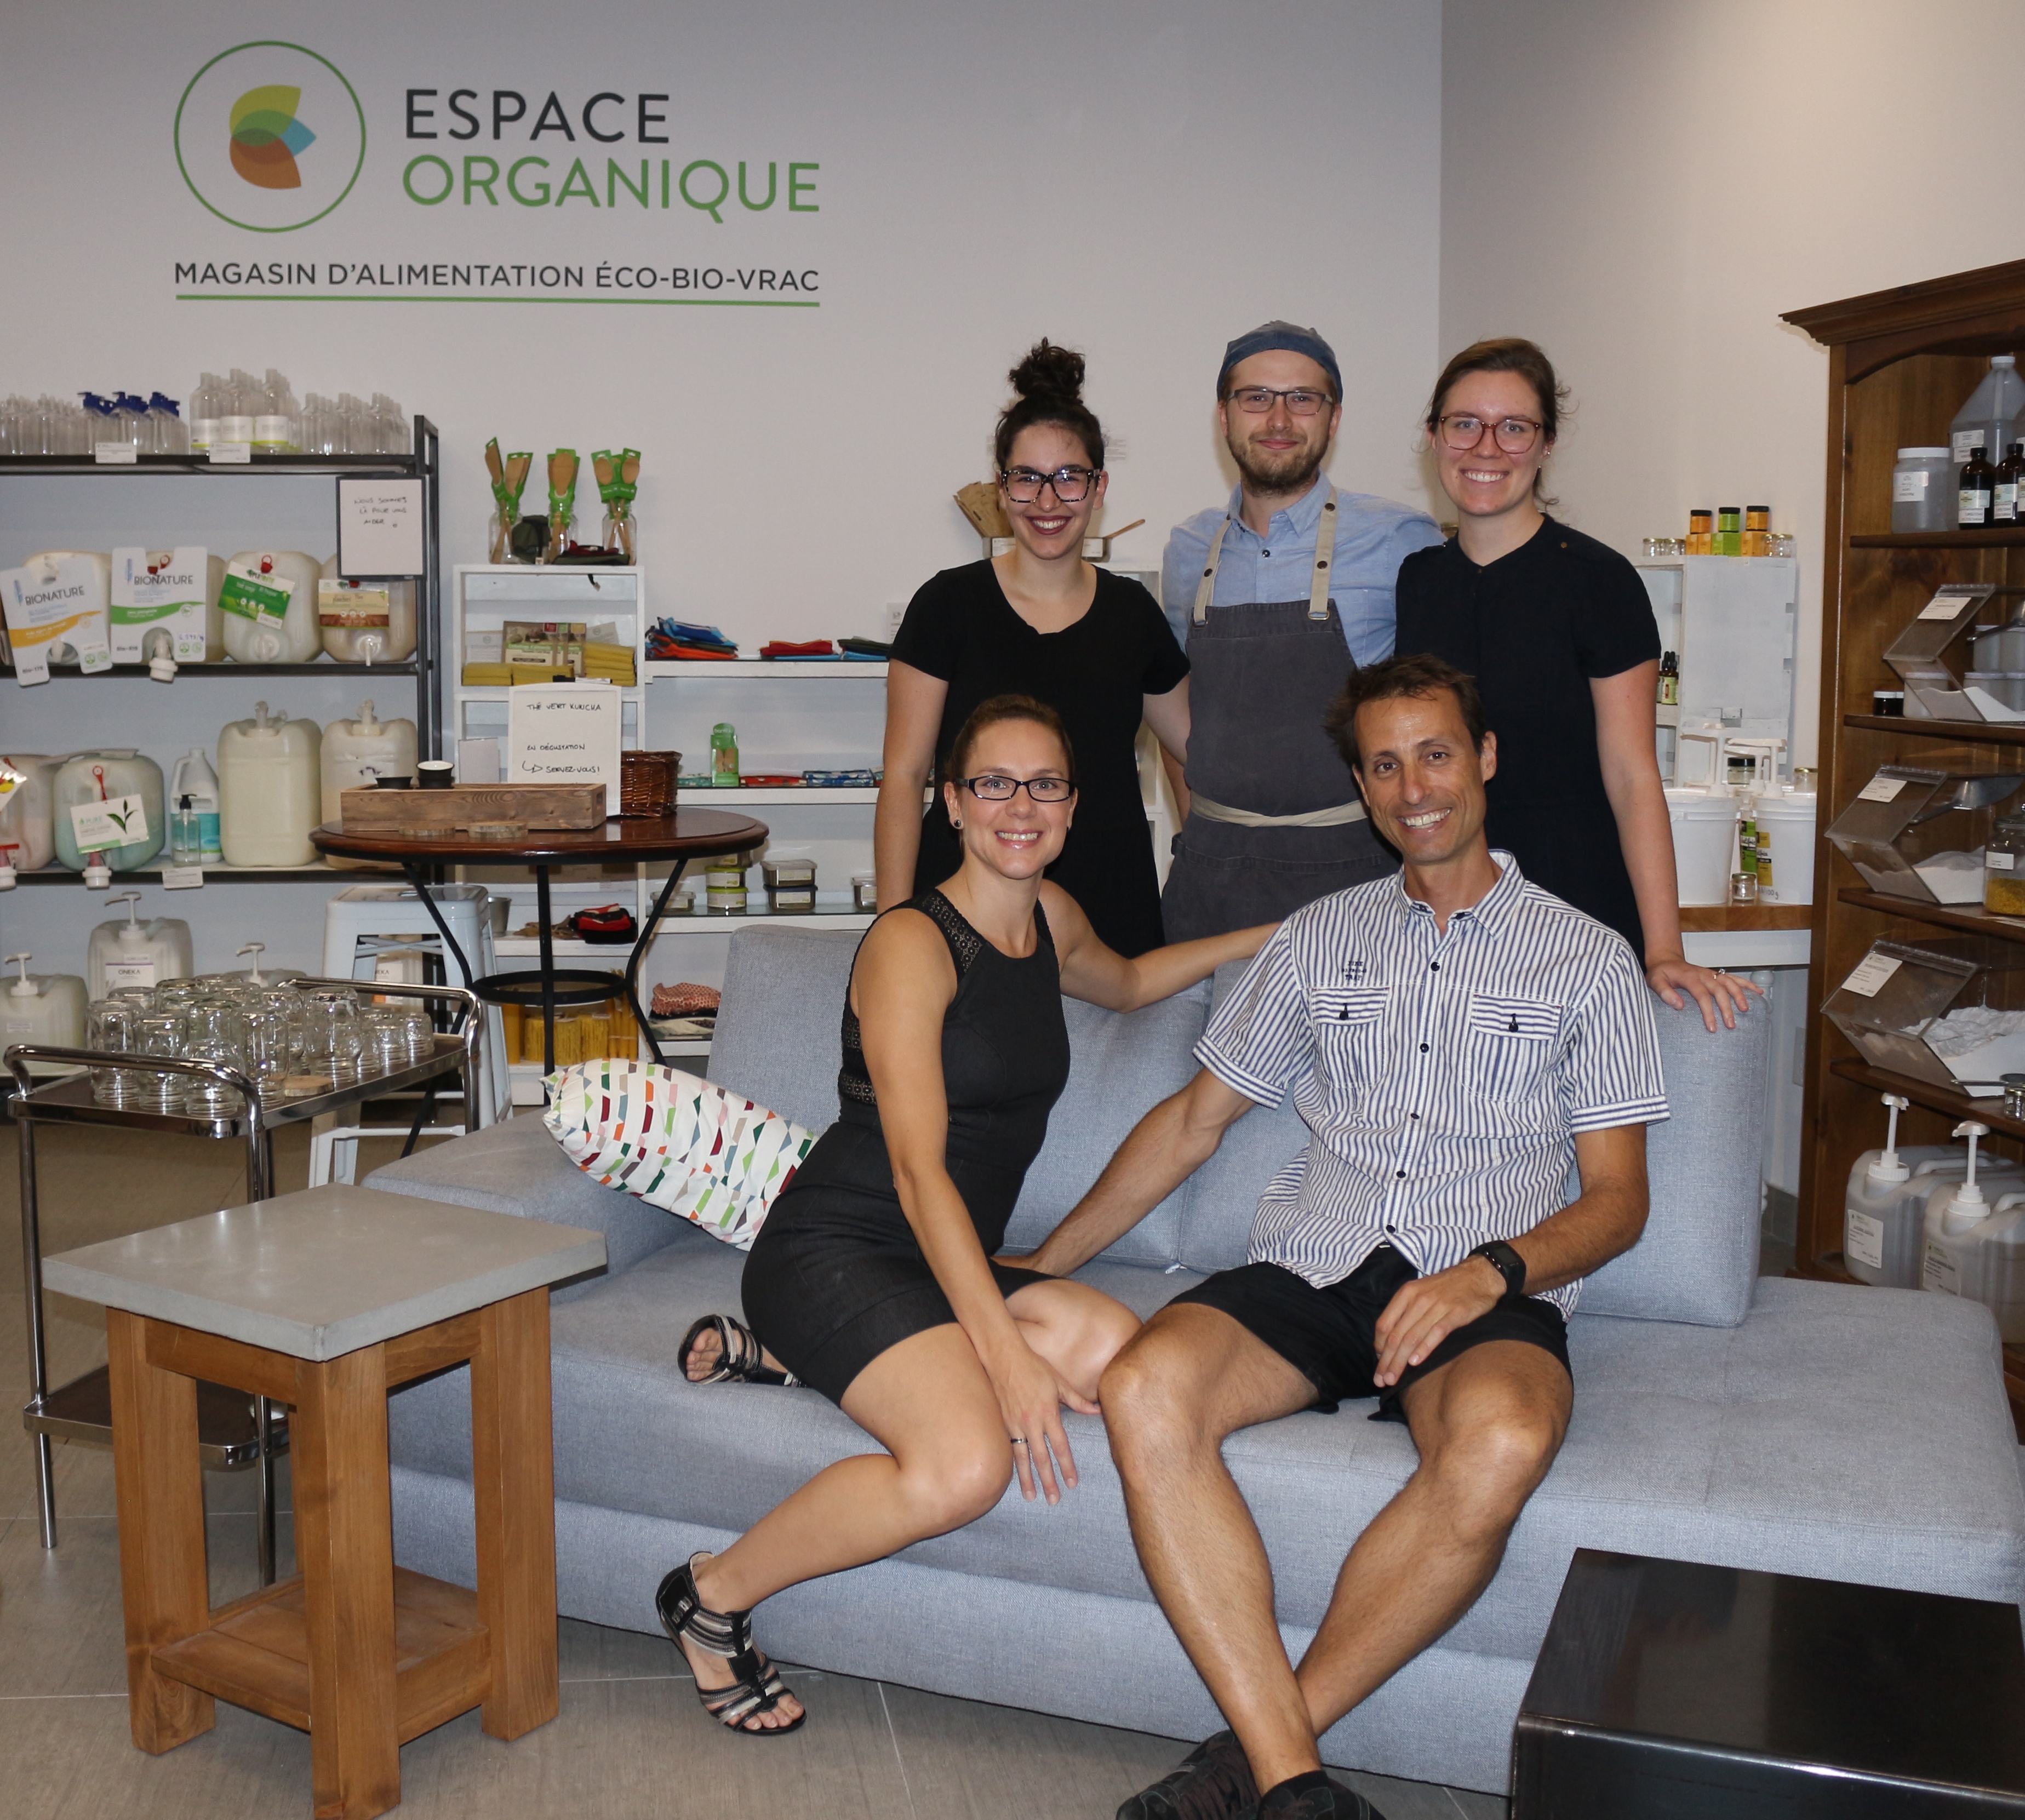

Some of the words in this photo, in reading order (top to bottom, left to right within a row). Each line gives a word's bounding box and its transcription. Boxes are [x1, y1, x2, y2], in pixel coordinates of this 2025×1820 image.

[406, 88, 671, 144] ESPACE
[403, 154, 821, 225] ORGANIQUE
[175, 262, 316, 285] MAGASIN
[329, 263, 584, 288] D'ALIMENTATION
[596, 261, 820, 292] ÉCO-BIO-VRAC
[134, 575, 193, 586] BIONATURE
[25, 586, 85, 606] BIONATURE
[527, 702, 542, 711] THÉ
[540, 742, 585, 751] DÉGUSTATION
[546, 766, 600, 775] SERVEZ-VOUS!
